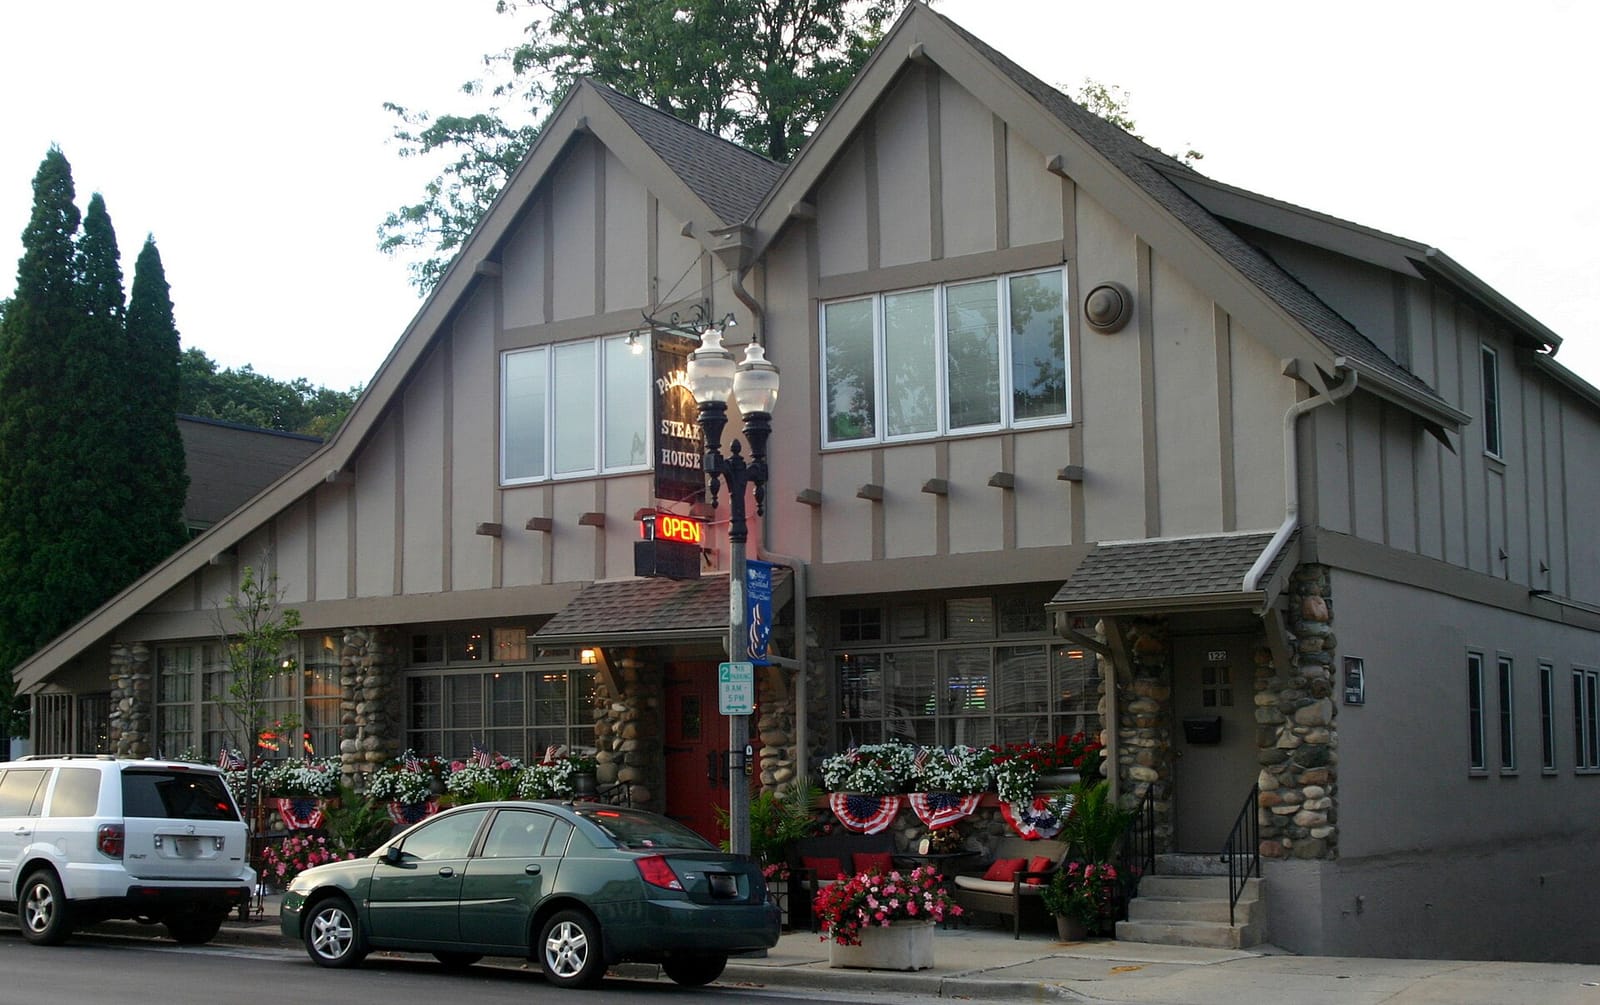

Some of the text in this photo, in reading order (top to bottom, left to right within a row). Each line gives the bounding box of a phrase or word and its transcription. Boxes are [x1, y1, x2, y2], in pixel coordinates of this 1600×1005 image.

[661, 419, 700, 439] STEAK
[661, 449, 700, 469] HOUSE
[663, 517, 700, 542] OPEN
[721, 666, 729, 680] 2
[728, 694, 733, 702] 5
